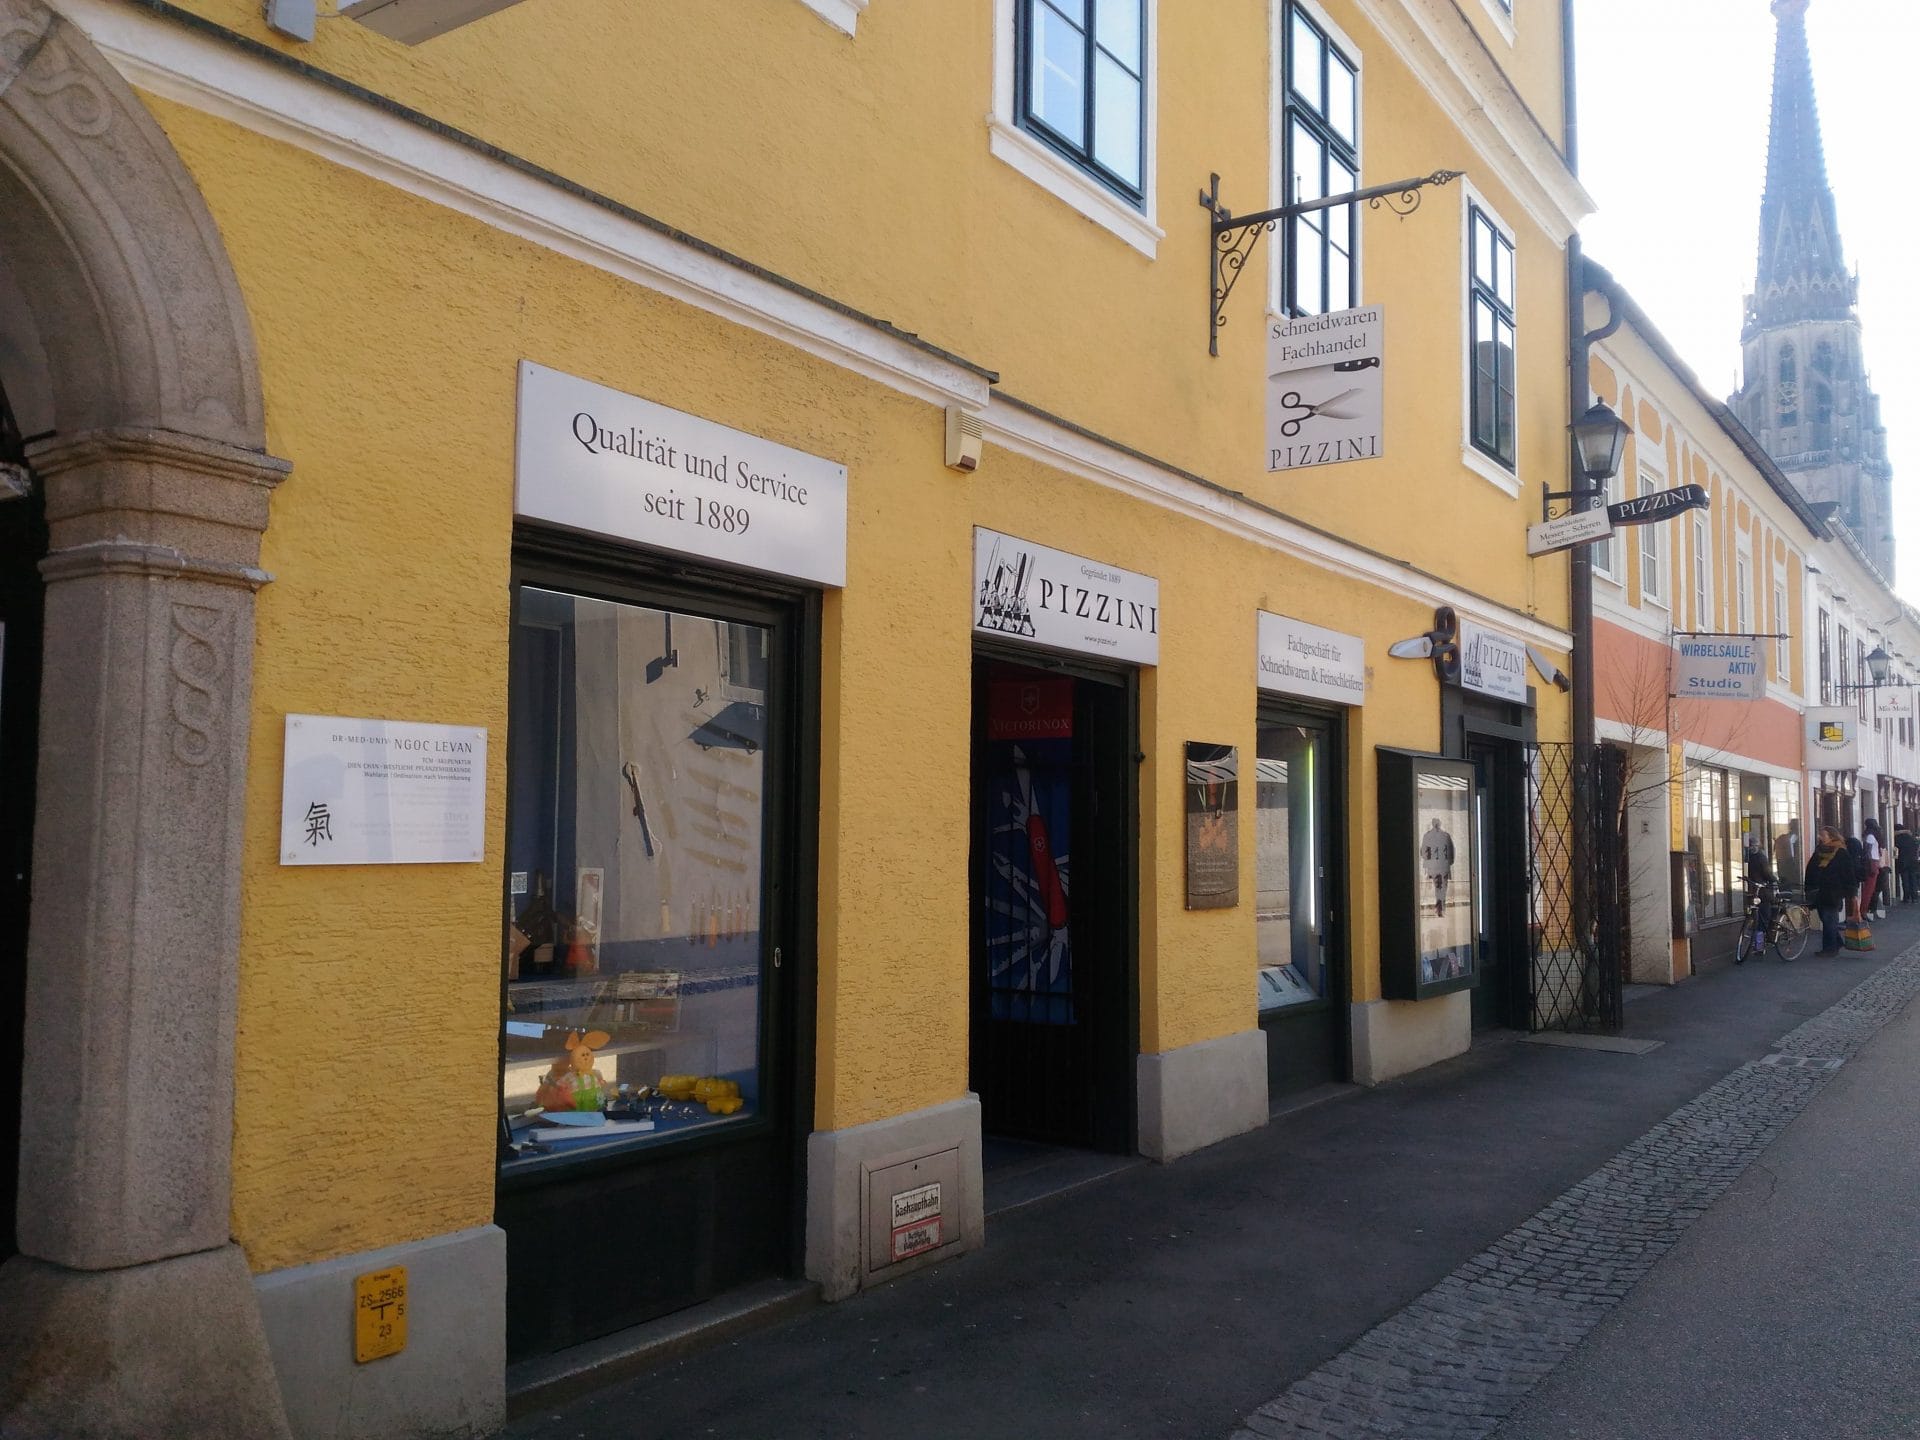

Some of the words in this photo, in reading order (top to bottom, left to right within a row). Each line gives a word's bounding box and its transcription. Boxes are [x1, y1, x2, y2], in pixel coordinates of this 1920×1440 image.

[1271, 311, 1377, 339] Schneidwaren
[1281, 333, 1367, 361] Fachhandel
[572, 412, 677, 470] Qualität
[684, 455, 729, 484] und
[735, 461, 808, 506] Service
[1271, 435, 1377, 469] PIZZINI
[644, 489, 686, 521] seit
[695, 497, 750, 535] 1889
[1619, 487, 1693, 518] PIZZINI
[1540, 530, 1565, 543] Messer
[1572, 520, 1601, 533] Scheren
[1039, 578, 1157, 634] PIZZINI
[1288, 634, 1330, 660] Fachgeschäft
[1331, 646, 1341, 662] für
[1483, 644, 1525, 676] PIZZINI
[1260, 655, 1310, 681] Schneidwaren
[1311, 666, 1319, 682] &
[1689, 676, 1742, 689] Studio
[1728, 662, 1756, 675] AKTIV
[993, 718, 1072, 732] VICTORINOX
[394, 739, 430, 751] NGOC
[435, 741, 472, 753] LEVAN
[303, 801, 333, 847] 氣
[895, 1194, 938, 1217] Gashaupthahn
